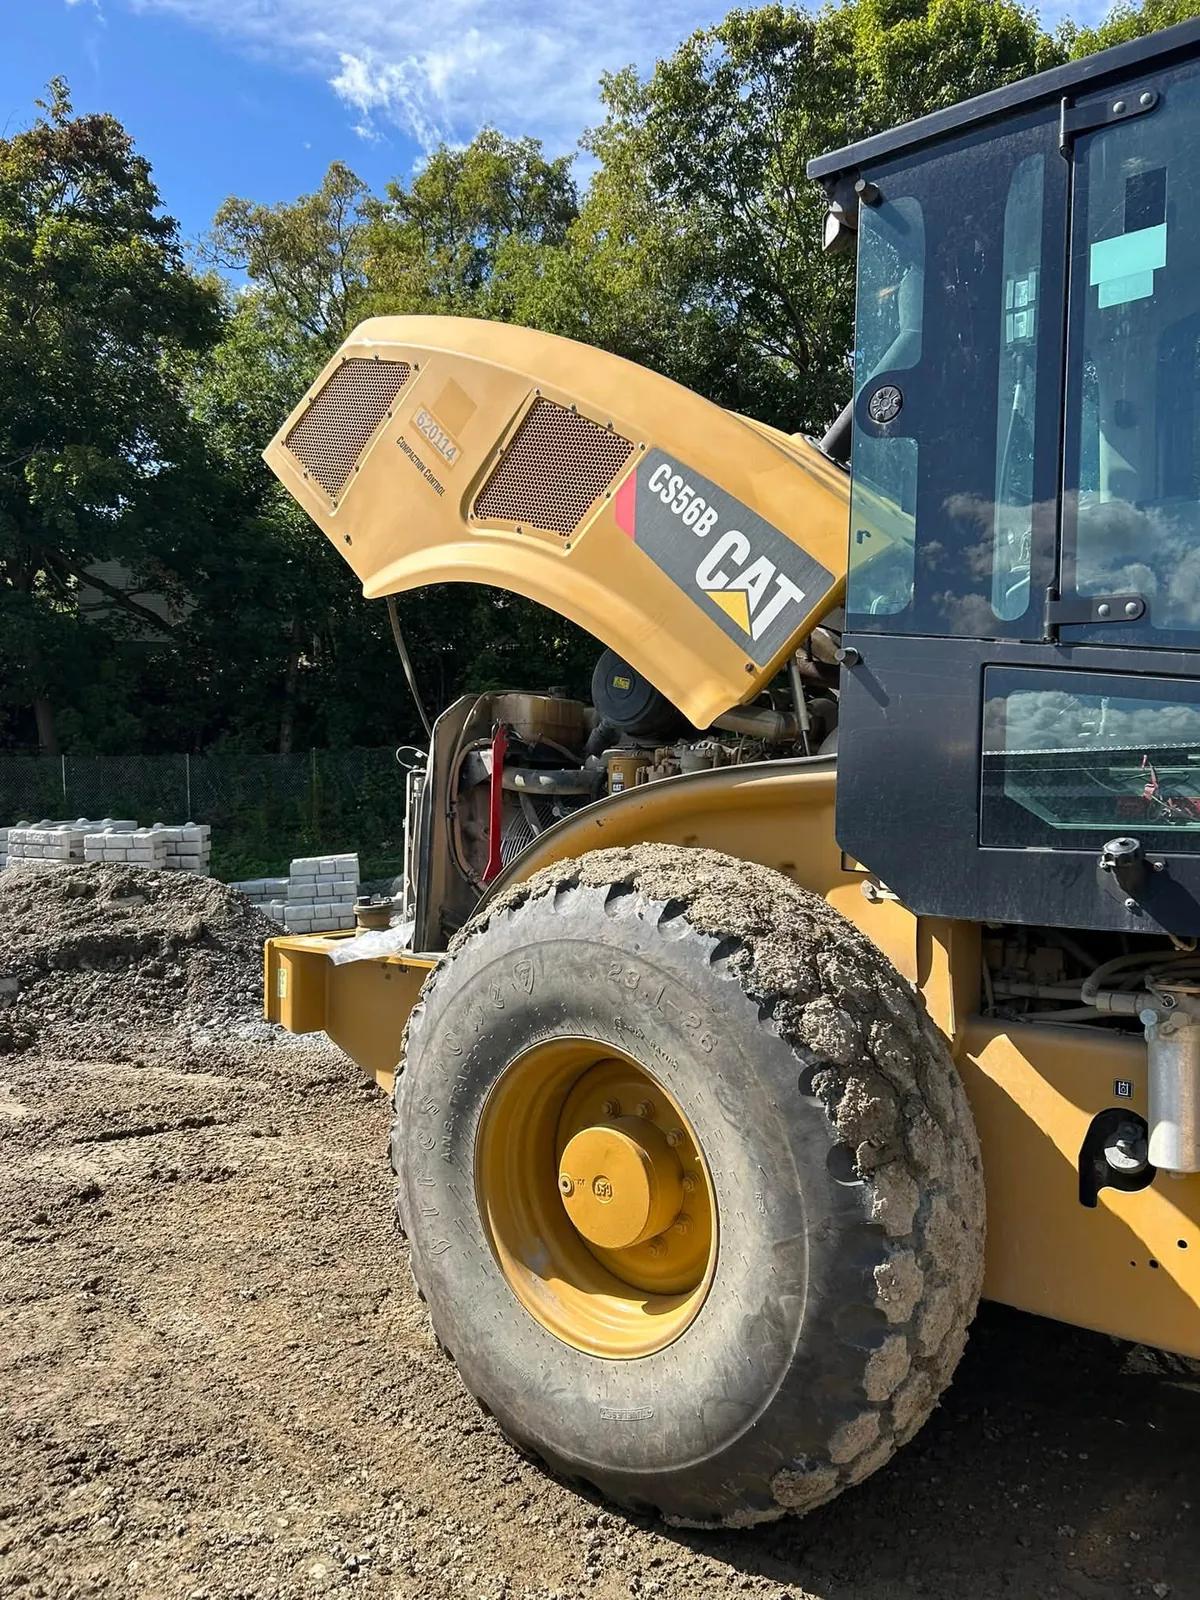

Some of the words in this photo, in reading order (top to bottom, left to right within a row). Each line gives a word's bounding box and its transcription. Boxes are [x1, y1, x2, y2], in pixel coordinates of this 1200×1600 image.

[396, 435, 427, 473] COMPACTION
[423, 468, 446, 497] CONTROL
[416, 410, 457, 461] 620114
[648, 463, 719, 537] CS56B
[696, 530, 806, 641] CAT
